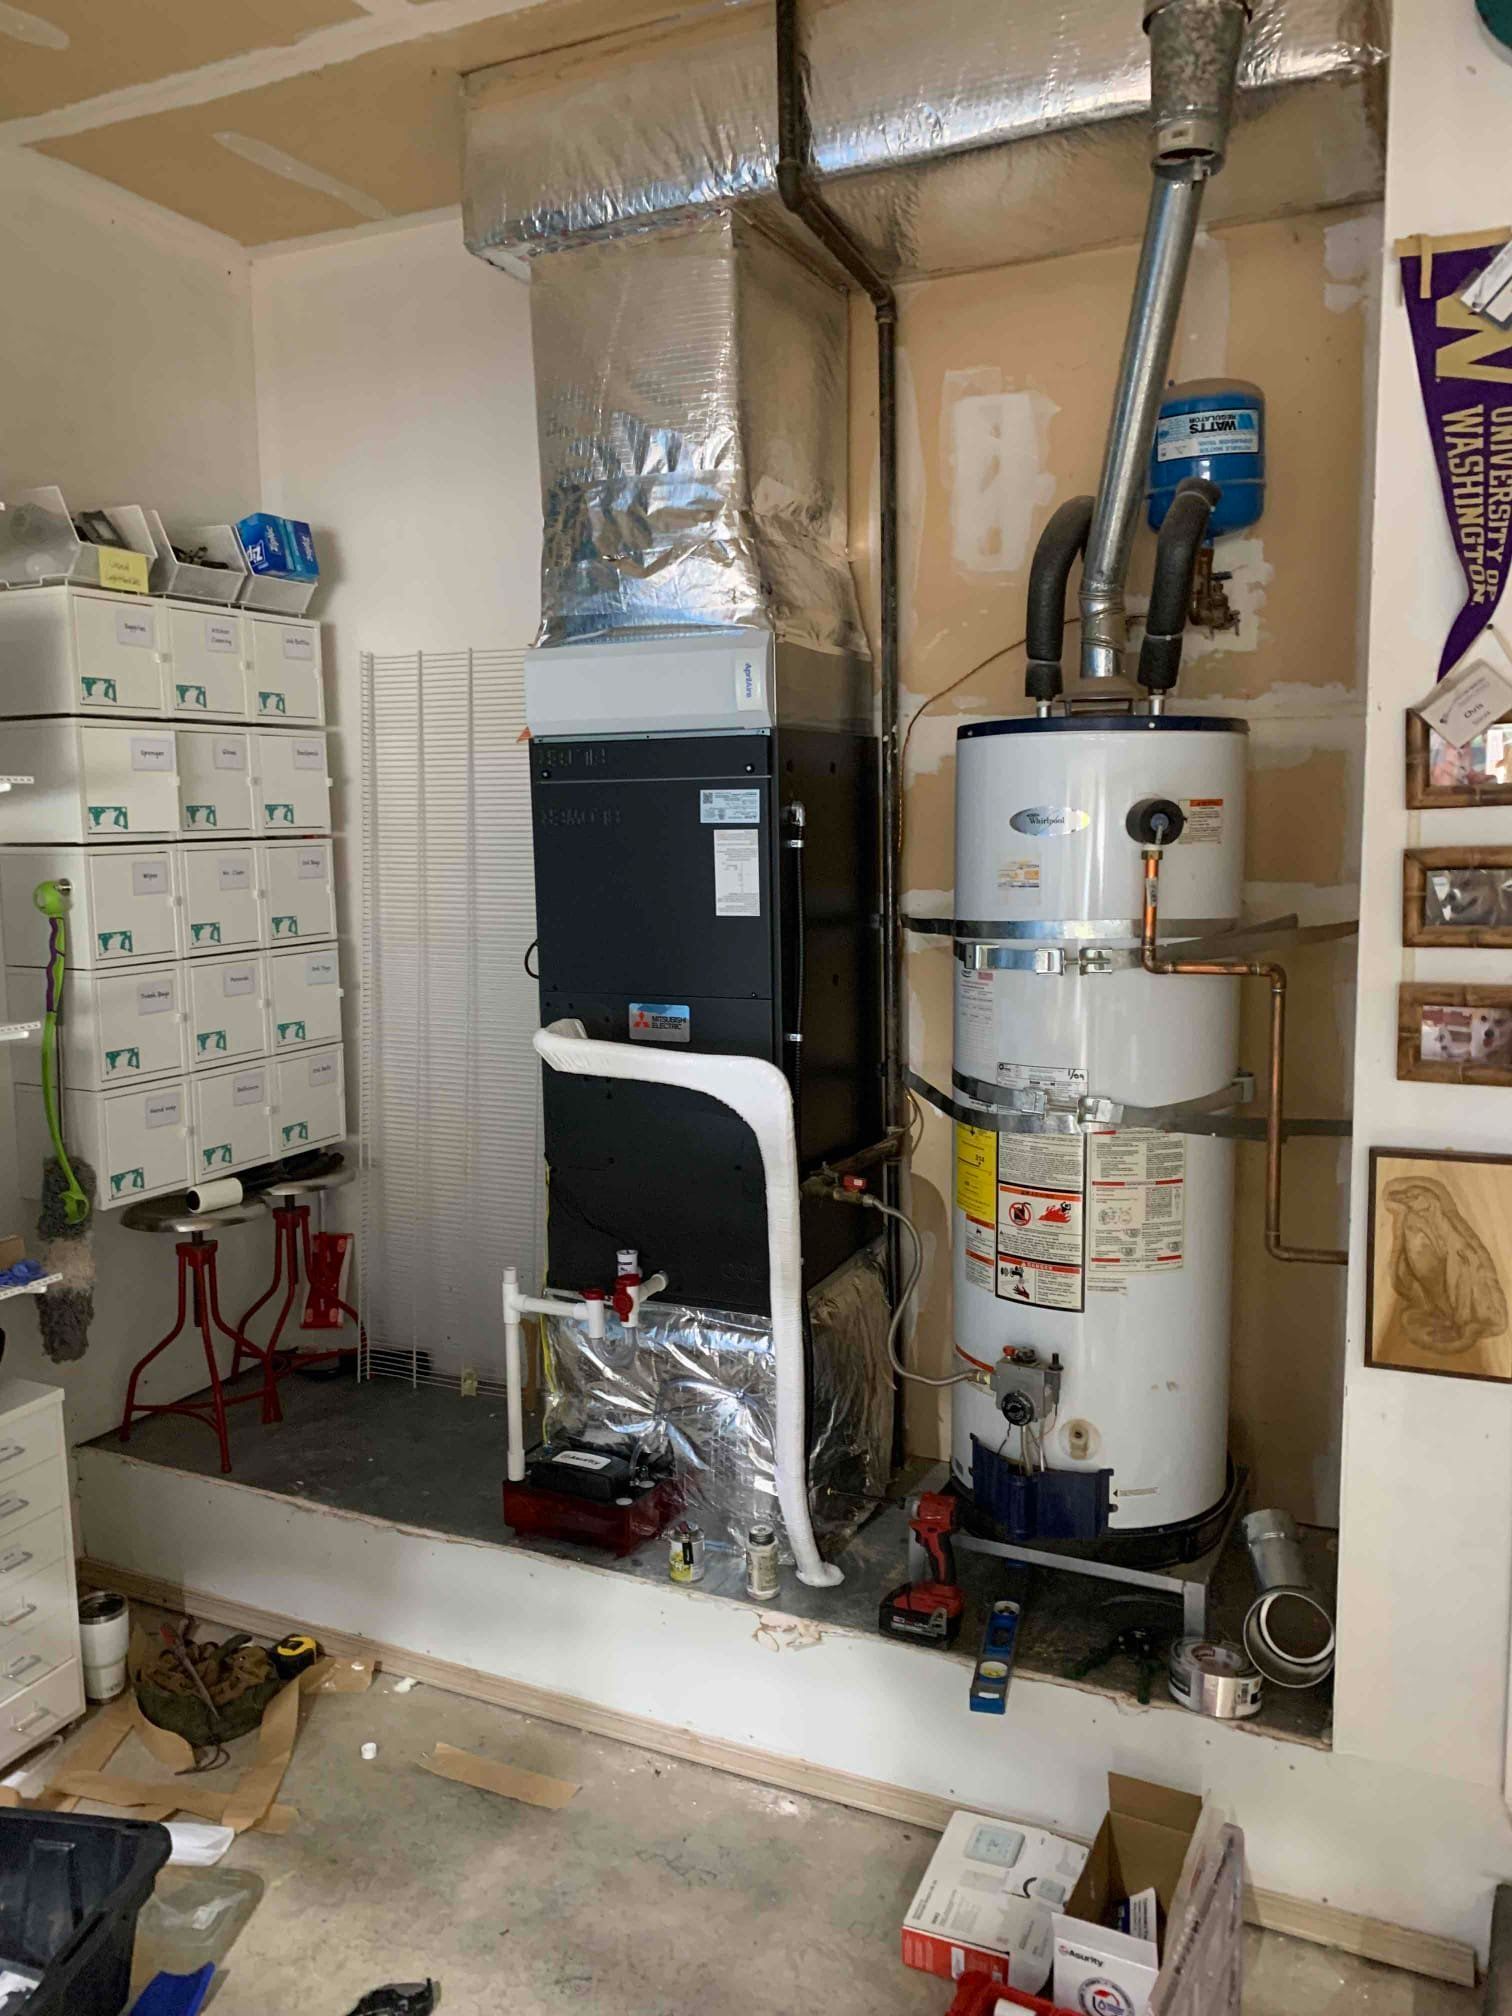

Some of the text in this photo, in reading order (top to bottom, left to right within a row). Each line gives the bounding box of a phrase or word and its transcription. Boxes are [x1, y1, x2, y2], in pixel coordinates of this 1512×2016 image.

[1189, 414, 1237, 424] REGULATOR
[1189, 420, 1237, 434] WATTS
[1441, 403, 1486, 606] WASHINGTON
[1485, 568, 1500, 602] OF
[1463, 702, 1485, 719] Chris
[1028, 815, 1065, 827] Whirlpool
[651, 1015, 687, 1024] MITSUBISHI
[651, 1022, 682, 1030] ELECTRIC
[1068, 1949, 1104, 1968] Asurity
